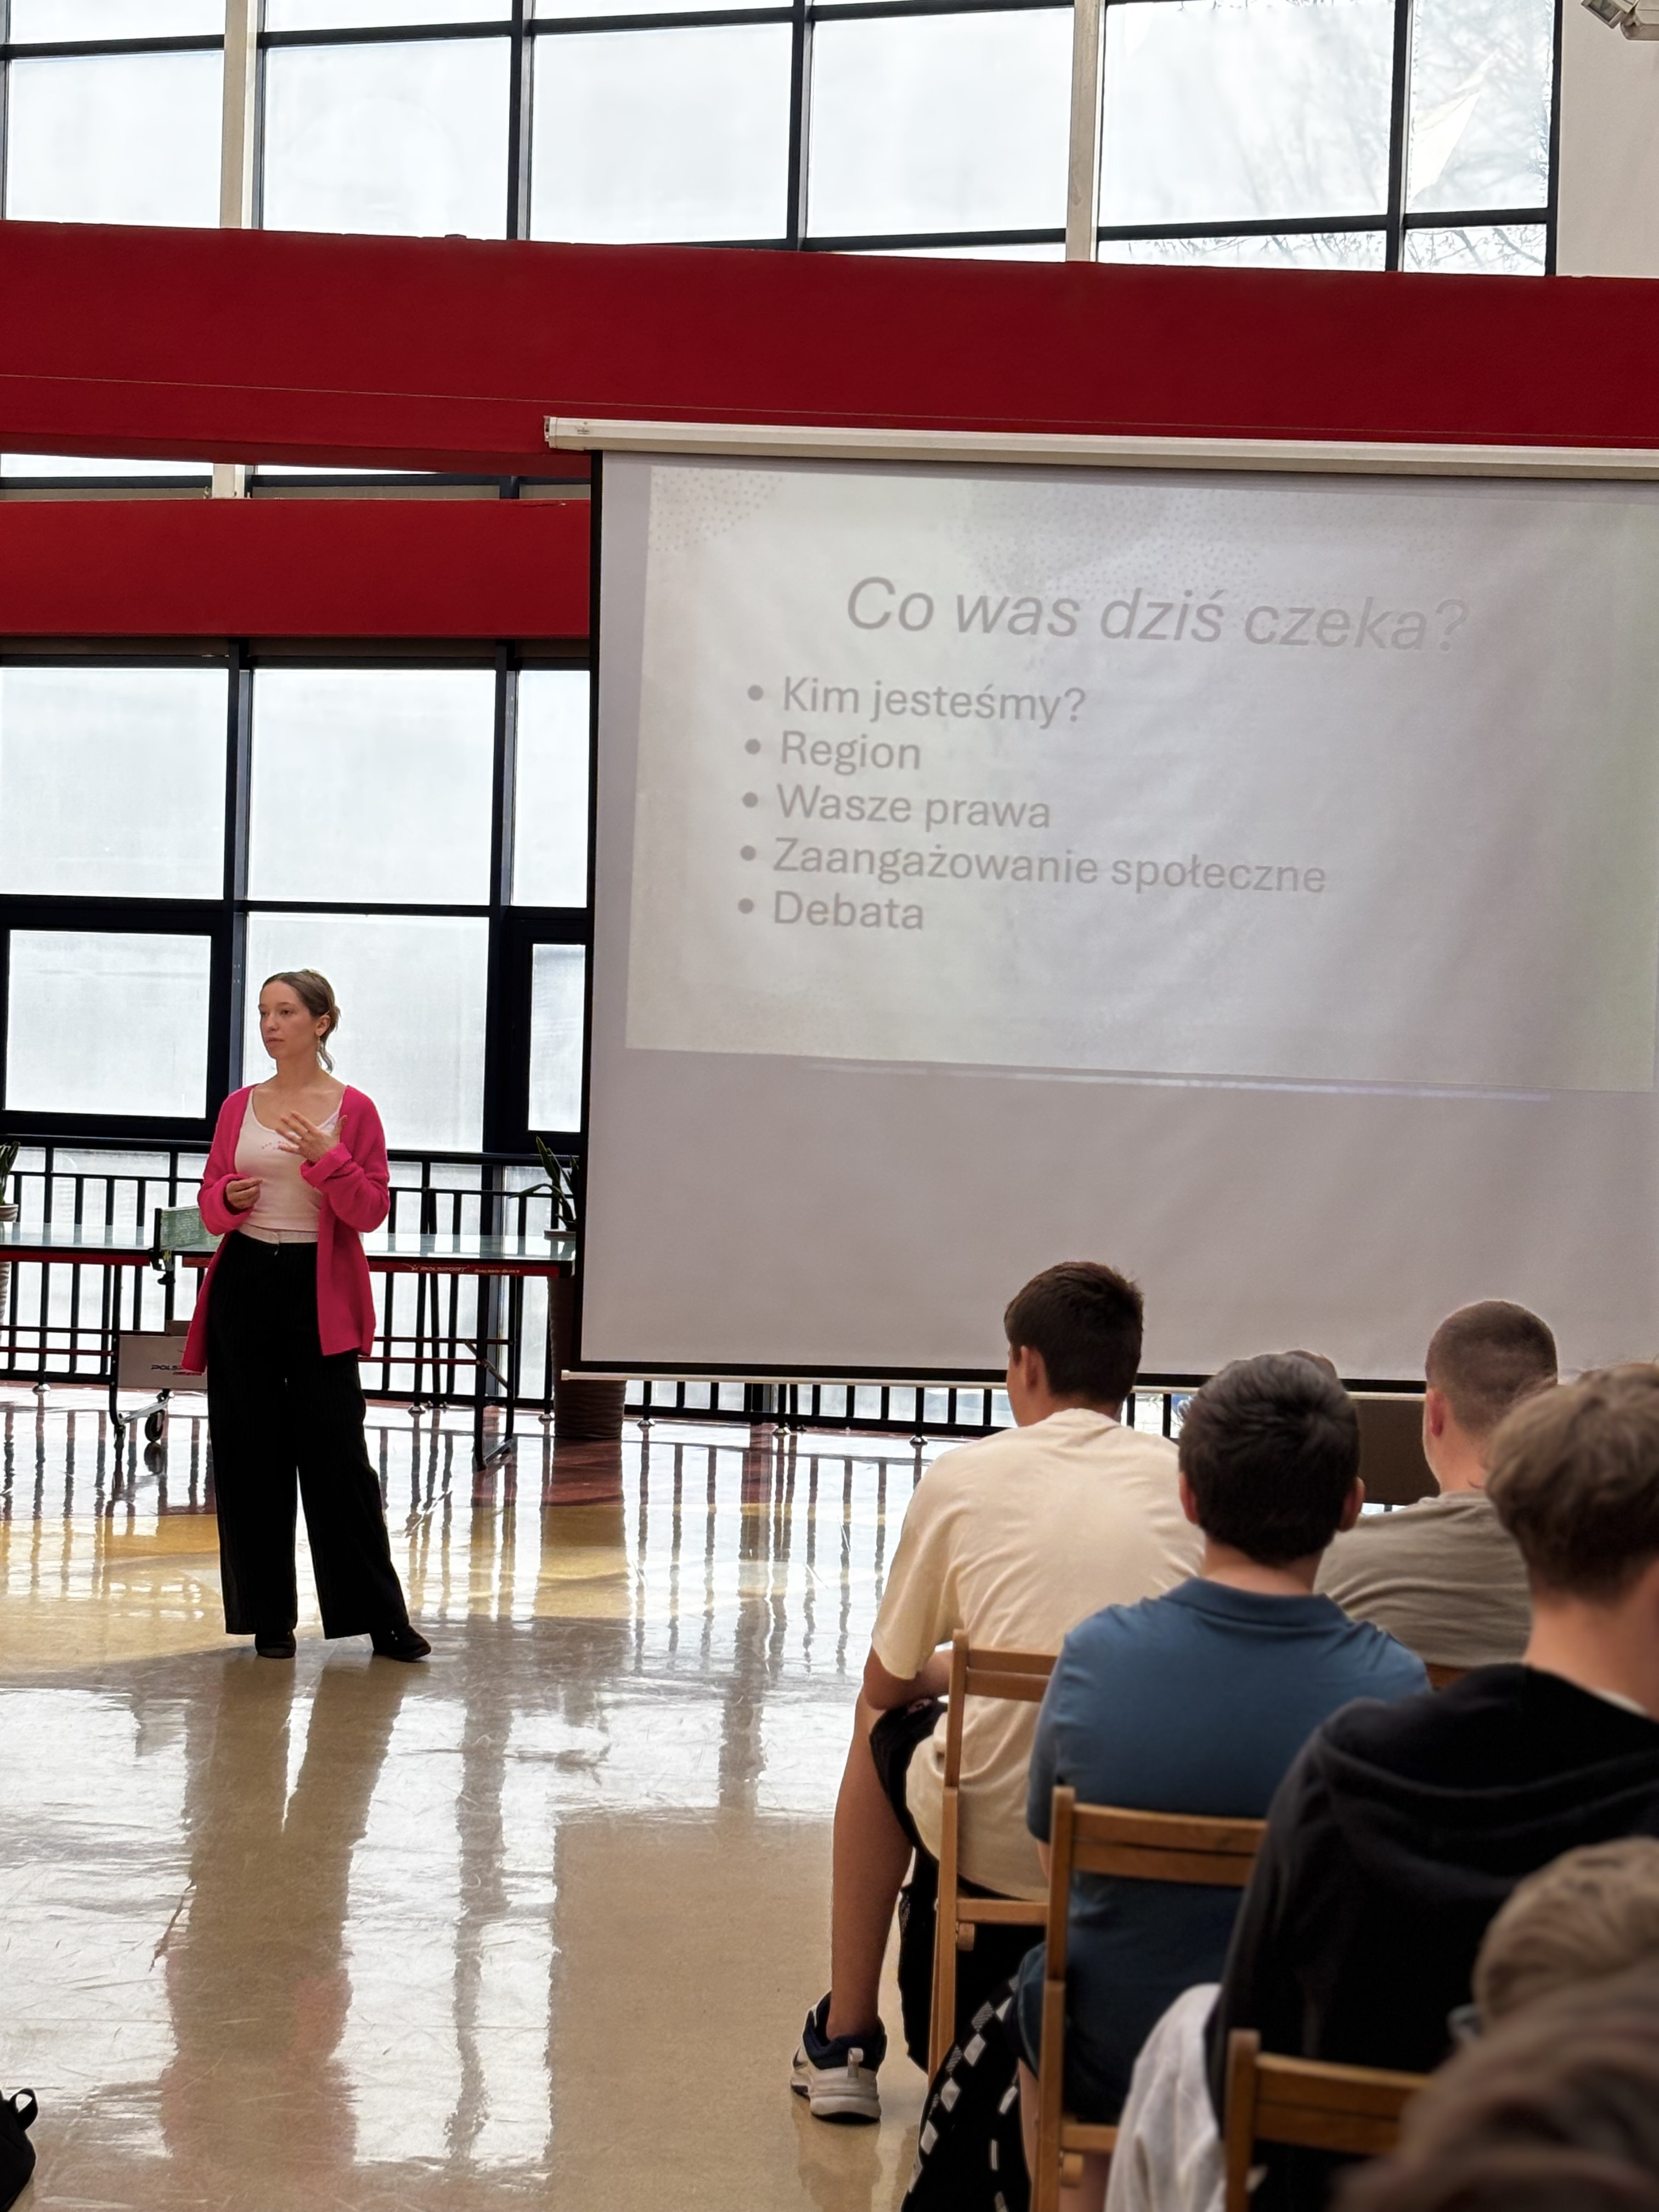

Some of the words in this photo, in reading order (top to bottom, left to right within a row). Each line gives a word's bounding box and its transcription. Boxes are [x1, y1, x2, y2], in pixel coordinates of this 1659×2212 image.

[847, 575, 935, 633] Co
[956, 593, 1082, 639] was
[1099, 586, 1228, 644] dziś
[1243, 595, 1470, 652] czeka?
[782, 675, 860, 714] Kim
[869, 680, 1088, 731] jesteśmy?
[780, 729, 922, 777] Region
[775, 782, 913, 824] Wasze
[924, 794, 1051, 833] prawa
[772, 836, 1099, 885] Zaangażowanie
[1110, 853, 1328, 895] społeczne
[773, 889, 925, 931] Debata
